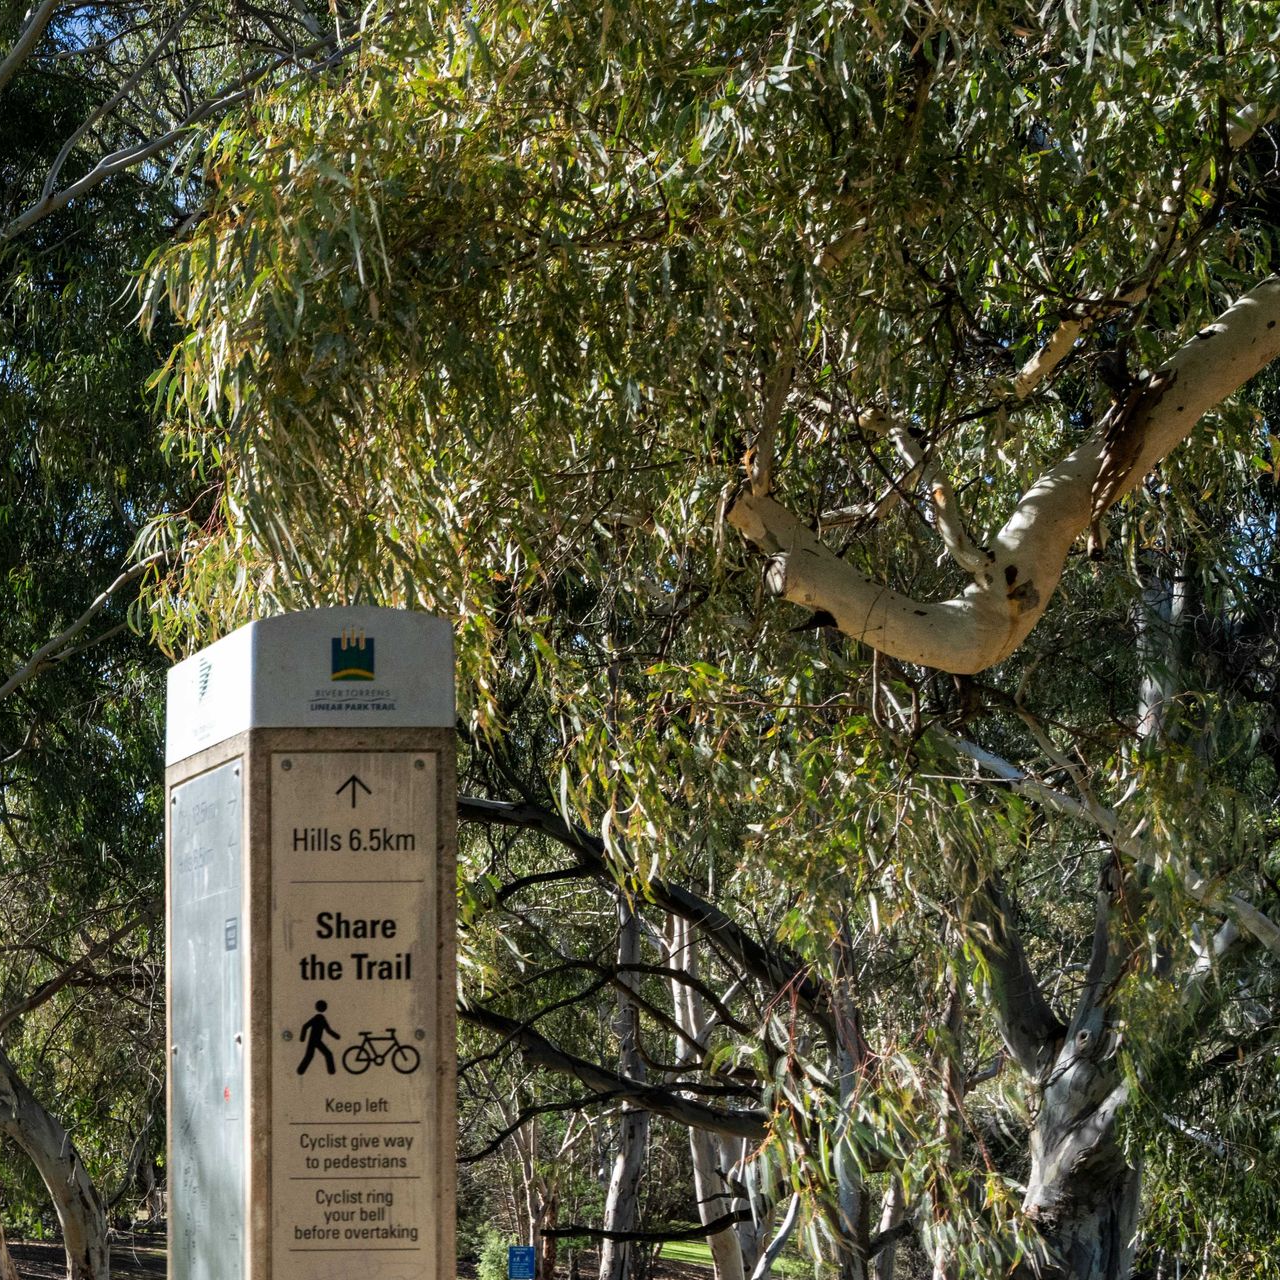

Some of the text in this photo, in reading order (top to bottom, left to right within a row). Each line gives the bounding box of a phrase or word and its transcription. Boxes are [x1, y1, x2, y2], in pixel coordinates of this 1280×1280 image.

[315, 689, 391, 697] RIVER TORRENS
[310, 703, 396, 711] LINEAR PARK TRAIL
[293, 828, 416, 852] Hills 6.5km
[316, 911, 397, 939] Share
[299, 953, 412, 981] the Trail
[325, 1097, 389, 1116] Keep left
[299, 1133, 414, 1152] Cyclist give way
[305, 1154, 408, 1172] to pedestrians
[315, 1189, 394, 1208] Cyclist ring
[323, 1207, 385, 1225] your bell
[294, 1224, 419, 1243] before overtaking
